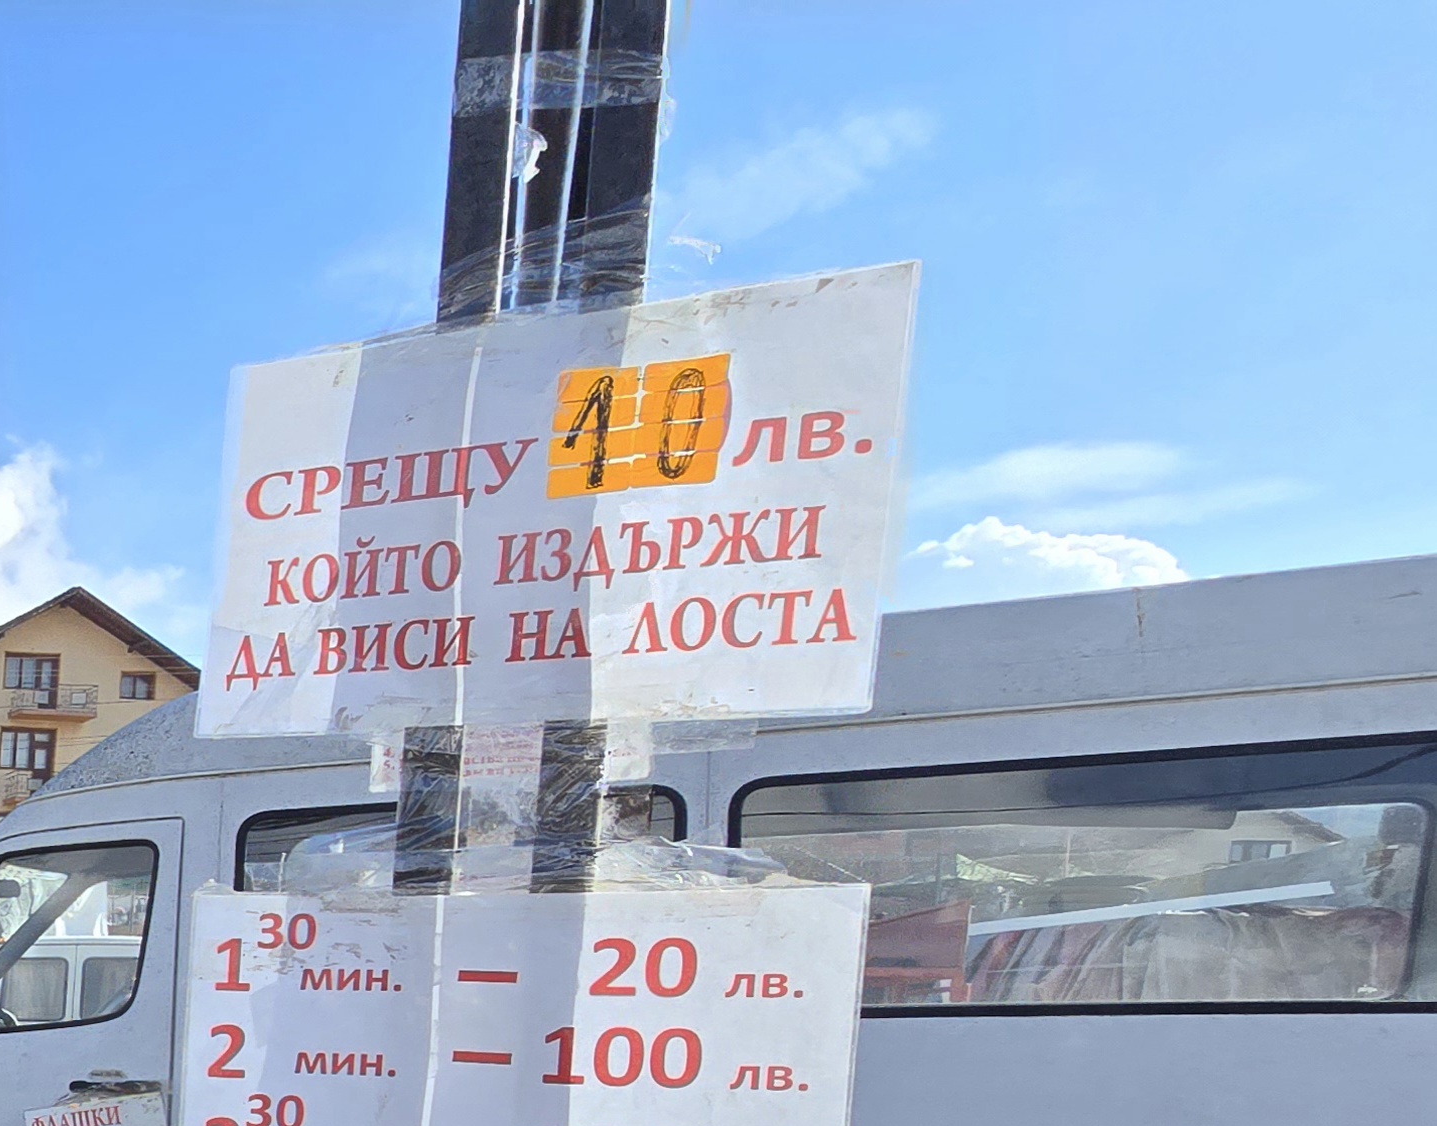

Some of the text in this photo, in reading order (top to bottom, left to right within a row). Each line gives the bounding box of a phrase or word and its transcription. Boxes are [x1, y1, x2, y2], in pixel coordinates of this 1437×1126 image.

[244, 366, 874, 522] СРЕЩУ 10 лв.
[264, 503, 827, 607] КОЙТО ИЗДЪРЖИ
[224, 586, 857, 693] ДА ВИСИ НА ЛОСТА
[299, 965, 404, 994] мин.
[588, 936, 698, 997] 20
[724, 971, 805, 999] лв.
[206, 1023, 809, 1092] 2 мин. 100 лв.
